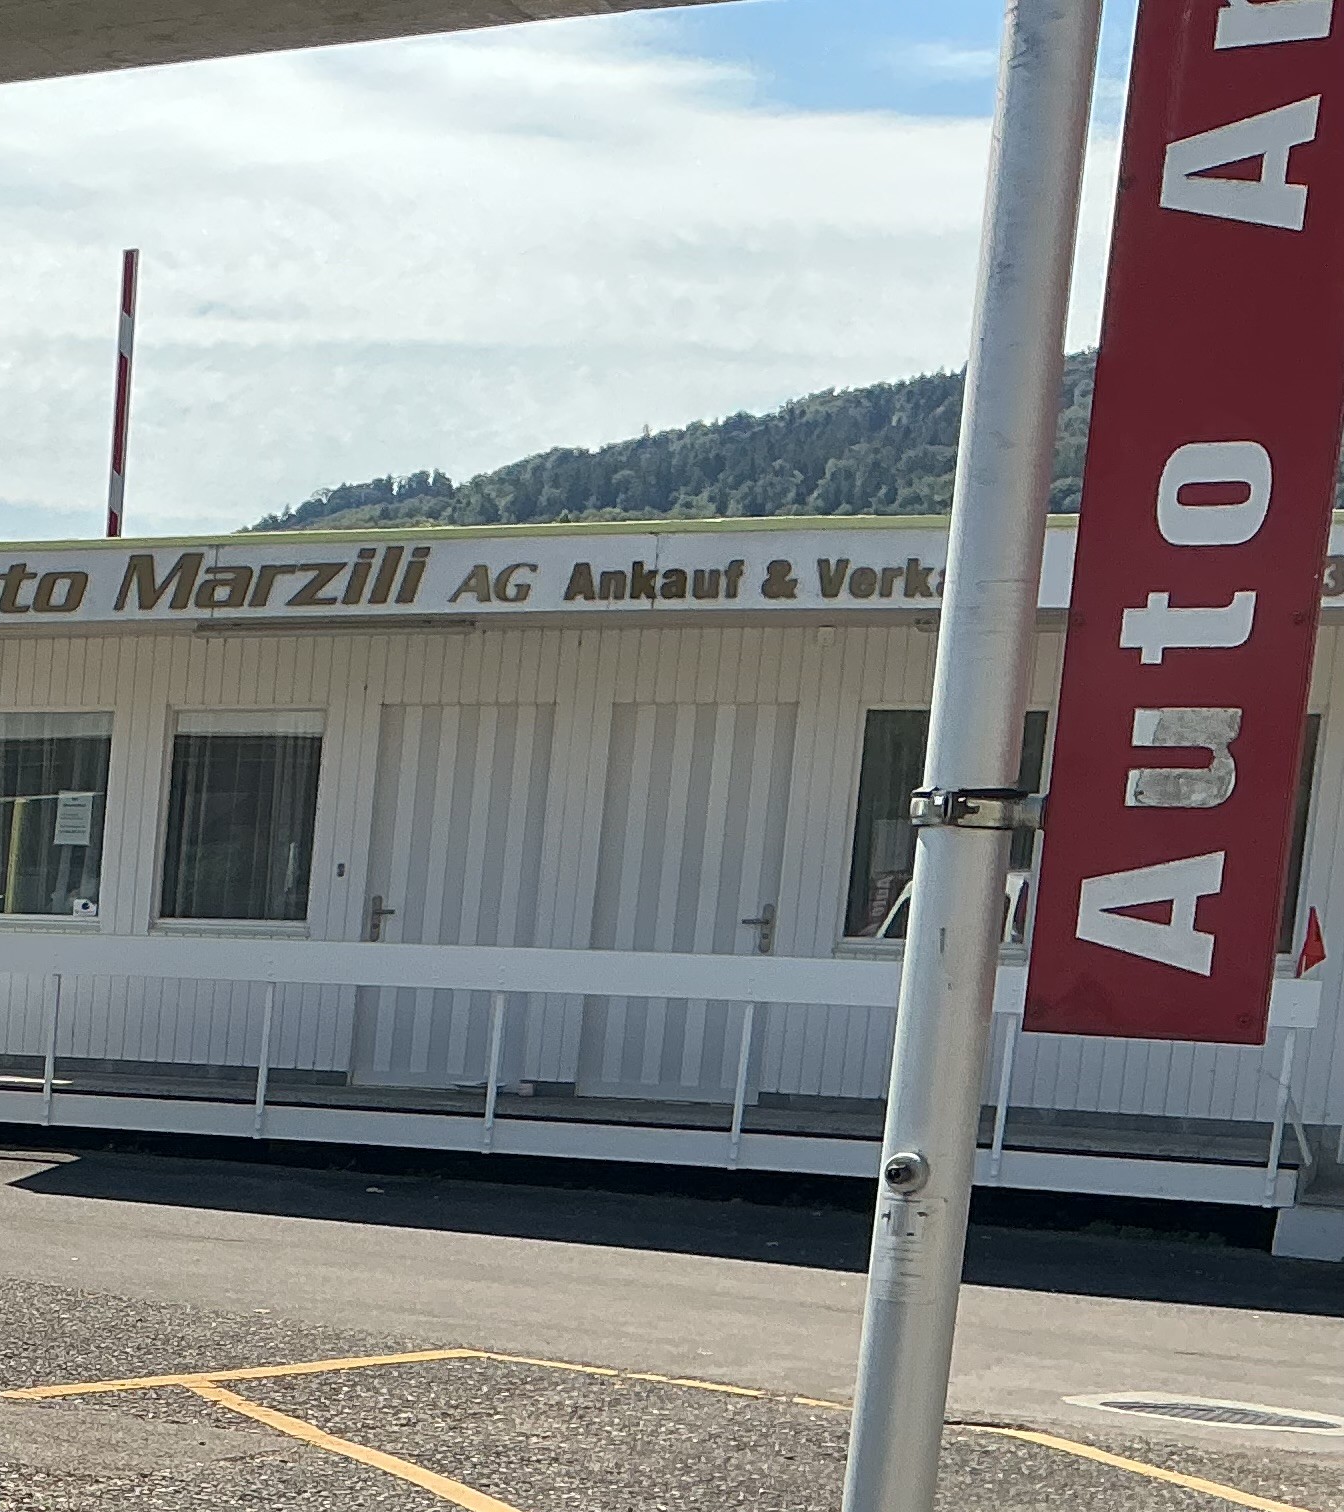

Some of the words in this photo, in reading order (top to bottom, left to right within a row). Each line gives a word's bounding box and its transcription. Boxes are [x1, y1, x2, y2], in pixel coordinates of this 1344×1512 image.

[112, 545, 431, 612] Marzili
[447, 562, 540, 603] AG
[564, 558, 746, 601] Ankauf
[760, 559, 798, 599] &
[1074, 438, 1276, 978] Auto
